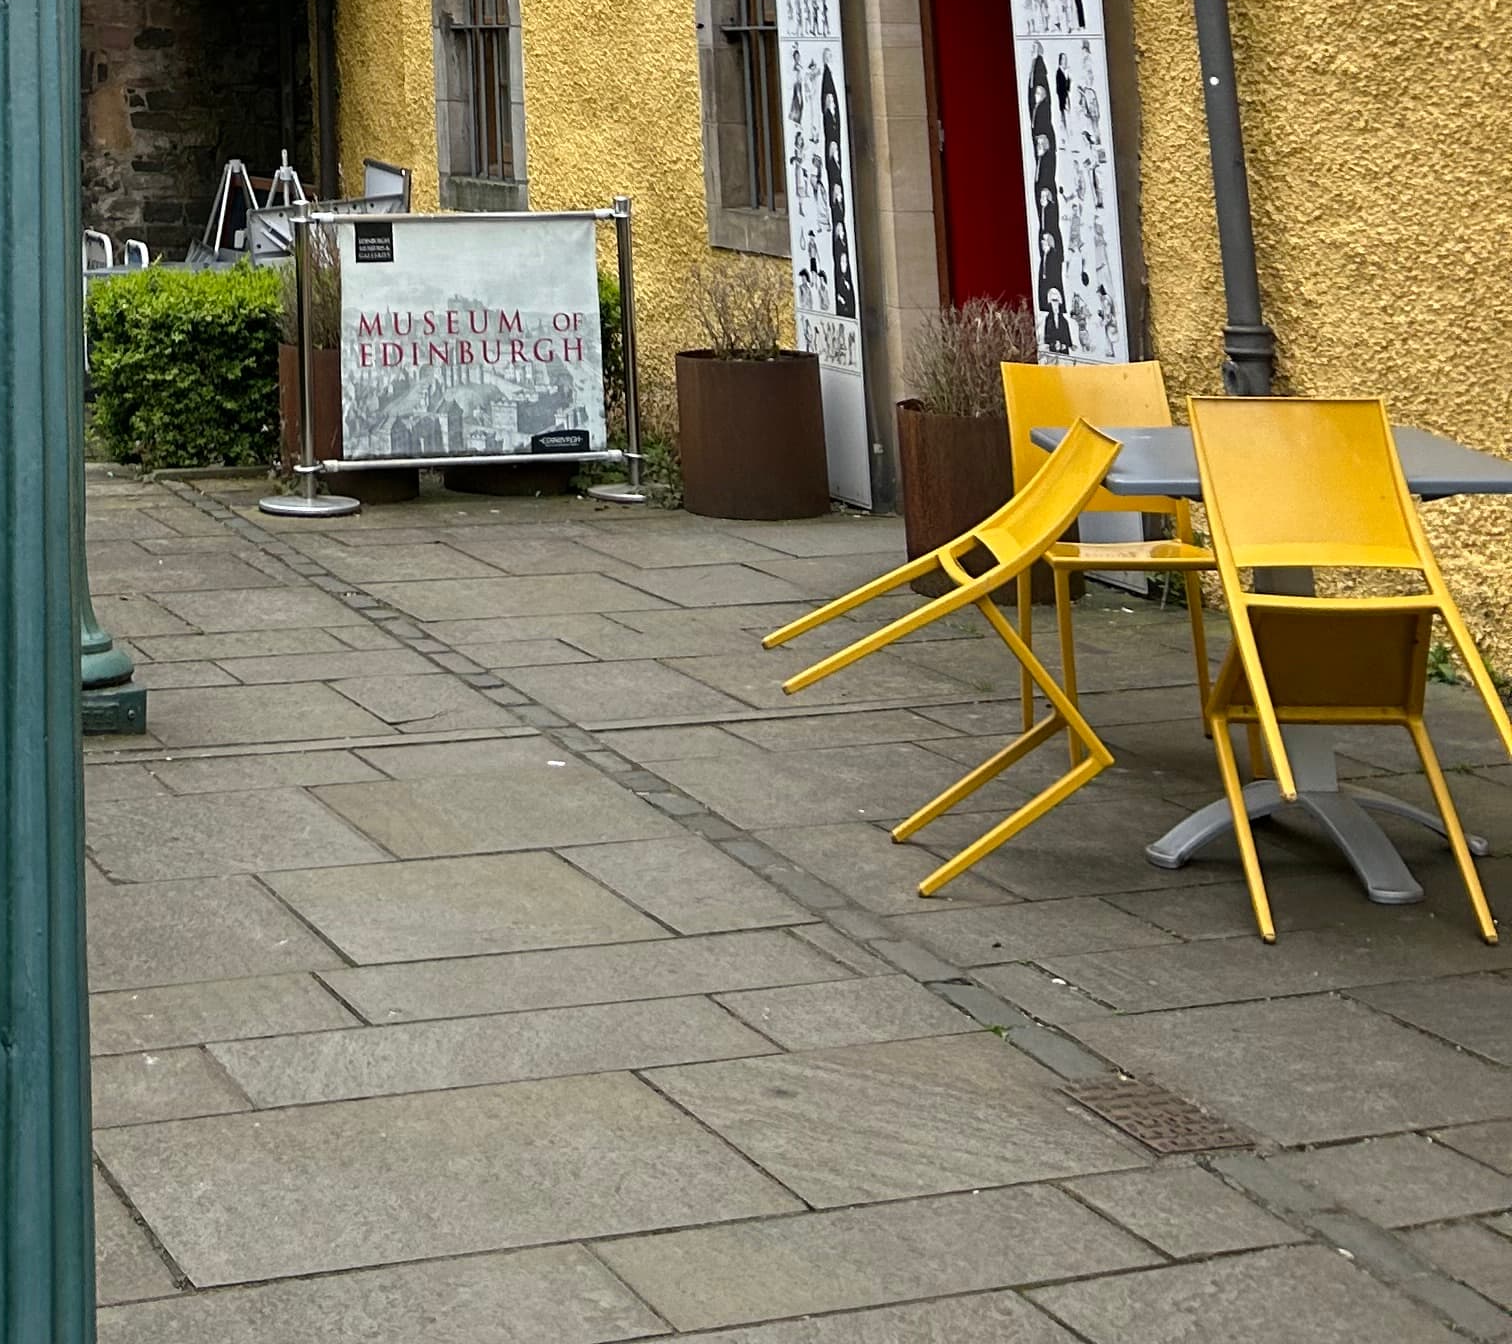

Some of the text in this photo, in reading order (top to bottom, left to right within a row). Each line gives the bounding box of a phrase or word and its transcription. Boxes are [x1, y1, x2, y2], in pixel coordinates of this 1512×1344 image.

[358, 308, 585, 337] MUSEUM OF
[359, 337, 585, 368] EDINBURGH
